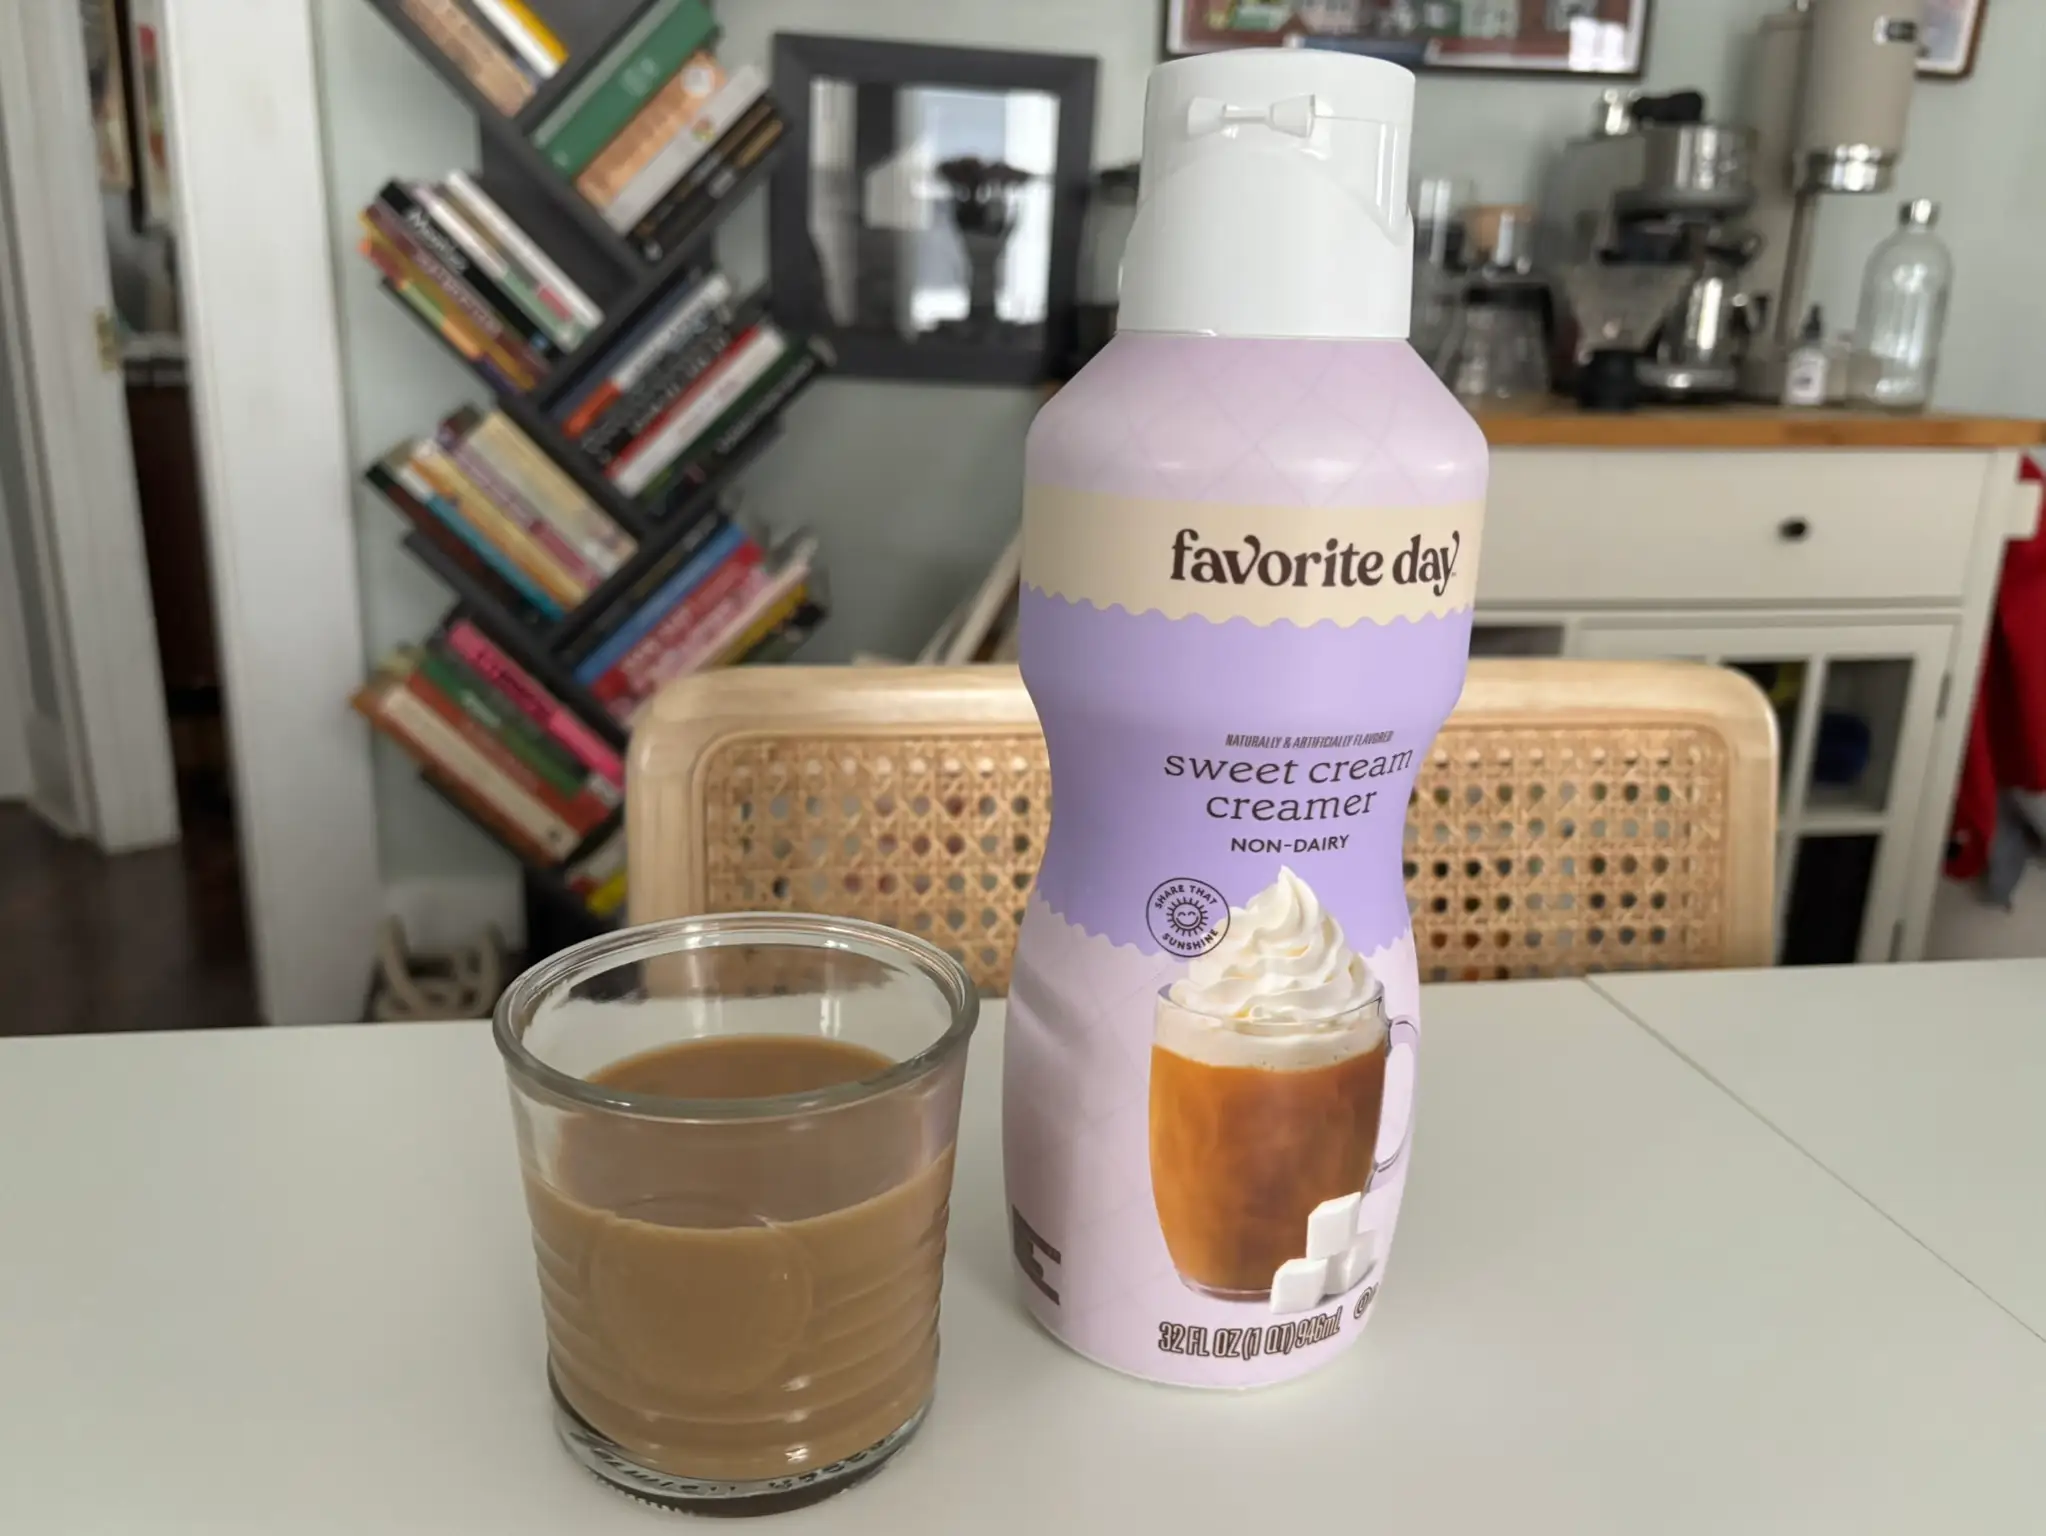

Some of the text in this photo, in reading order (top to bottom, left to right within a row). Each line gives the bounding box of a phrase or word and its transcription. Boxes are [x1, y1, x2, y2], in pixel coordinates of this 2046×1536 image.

[1170, 528, 1460, 597] favorite day
[1225, 730, 1394, 749] NATURALLY & ARTIFICIALLY FLAVORED
[1164, 750, 1413, 784] sweet cream
[1206, 791, 1377, 821] creamer
[1231, 834, 1349, 853] NON-DAIRY
[1155, 885, 1218, 909] SHARE THAT
[1162, 928, 1219, 950] SUNSHINE
[1158, 1306, 1343, 1360] 32 FL OZ (1 QT) 946mL
